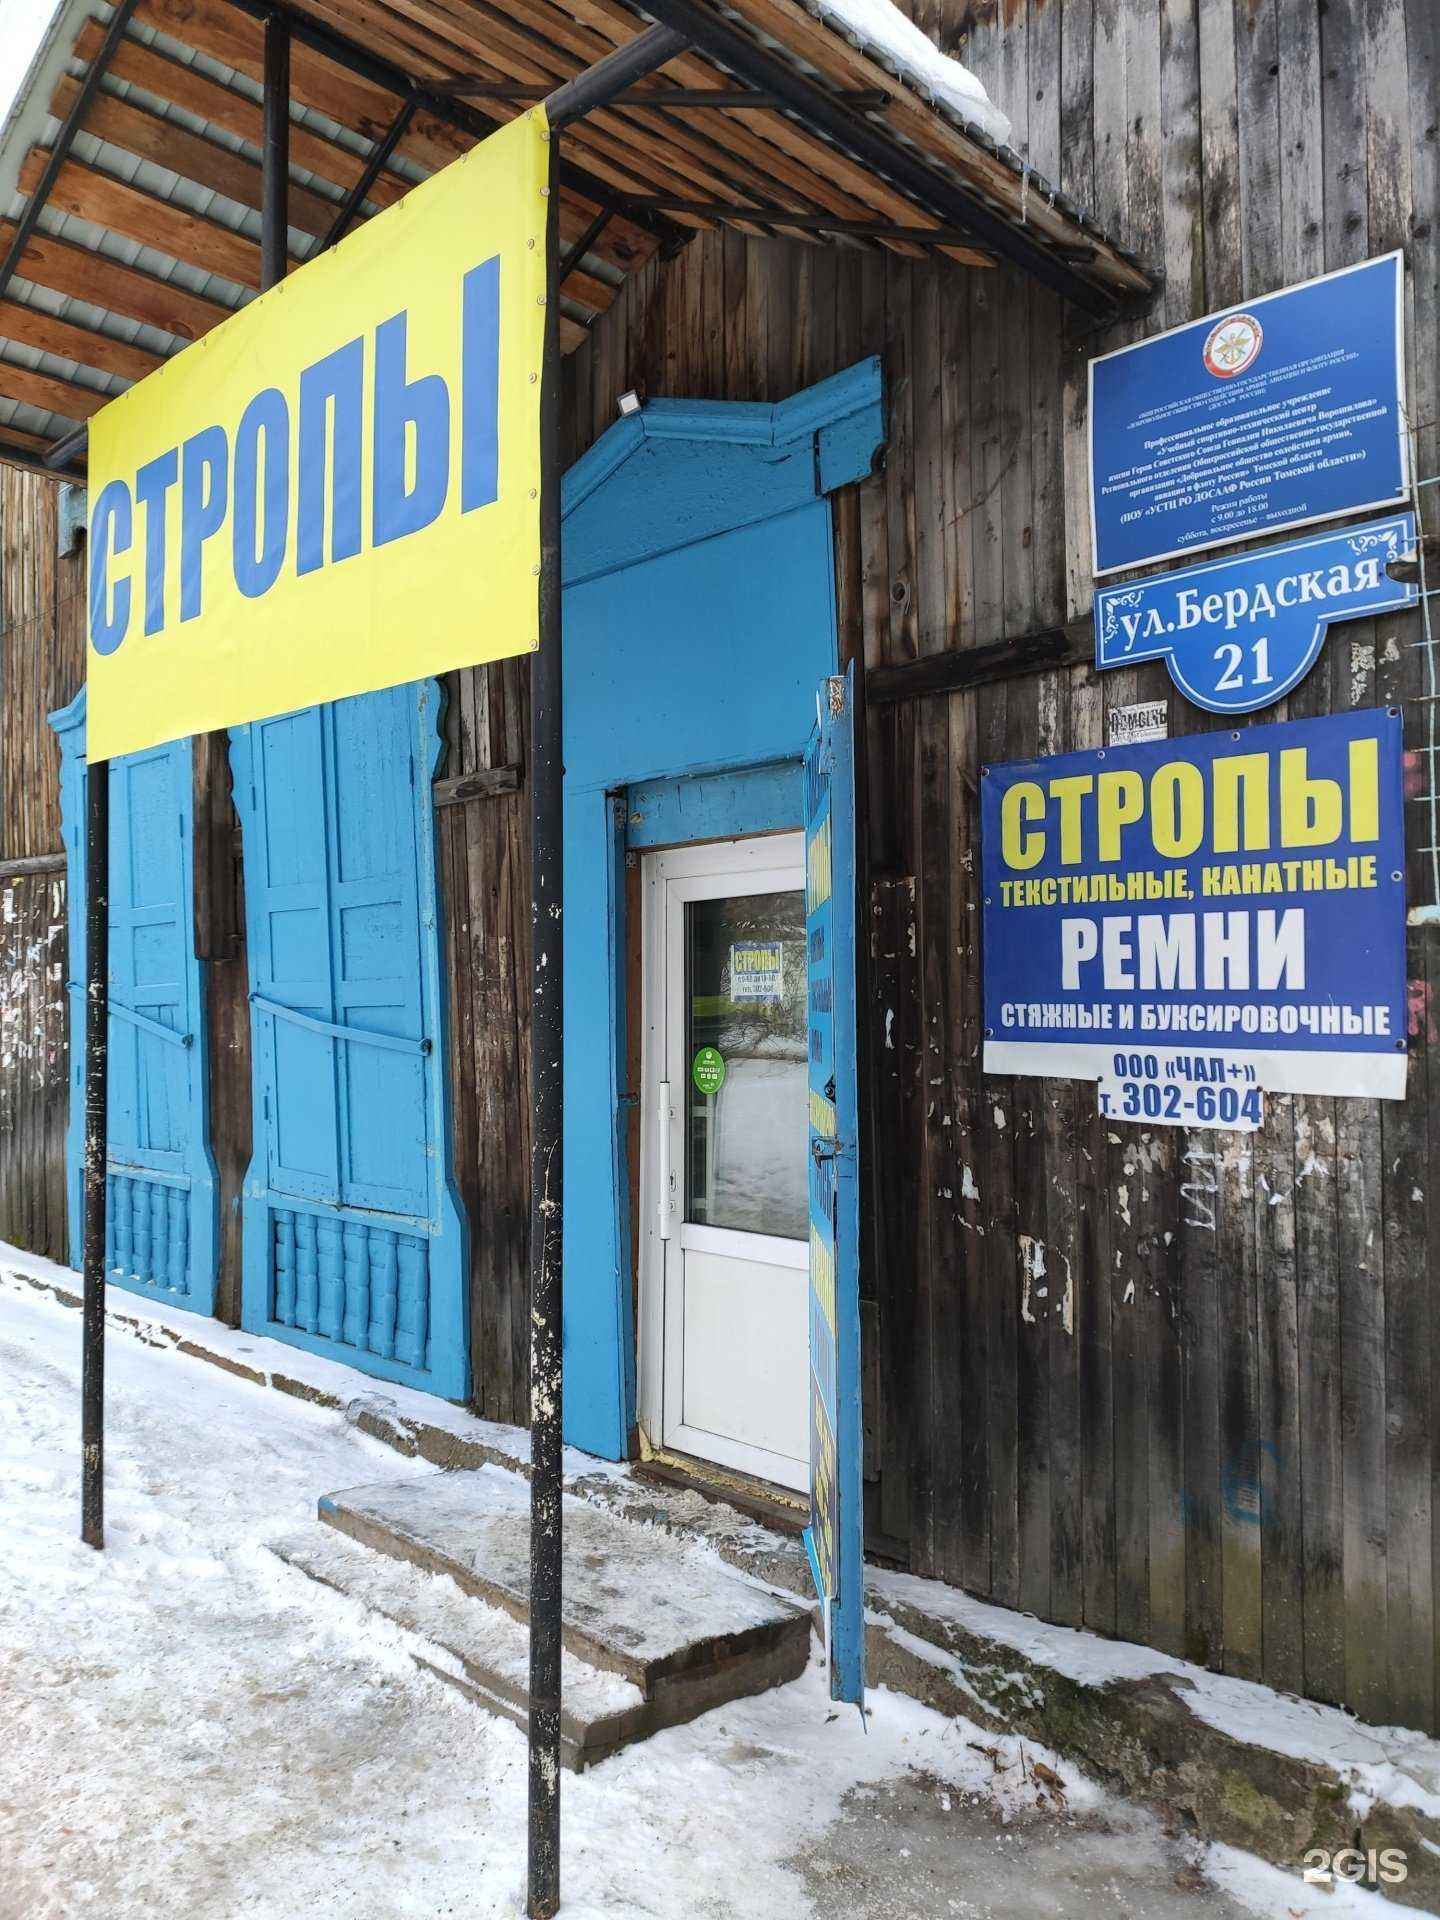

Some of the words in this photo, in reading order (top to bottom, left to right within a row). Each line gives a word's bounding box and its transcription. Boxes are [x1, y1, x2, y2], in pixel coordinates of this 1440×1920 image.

[90, 254, 500, 655] СТРОПЫ
[1214, 636, 1273, 692] 21
[1001, 738, 1380, 871] СТРОПЫ
[1000, 866, 1195, 908] ТЕКСТИЛЬНЫЕ,
[1202, 855, 1378, 896] КАНАТНЫЕ
[1062, 908, 1306, 991] РЕМНИ
[1001, 1003, 1113, 1030] СТЯЖНЫЕ
[1118, 1004, 1134, 1030] И
[1140, 1003, 1391, 1036] БУКСИРОВОЧНЫЕ
[1113, 1053, 1159, 1080] ООО
[1165, 1055, 1256, 1084] «ЧАЛ+»
[1100, 1093, 1117, 1114] т.
[1122, 1082, 1262, 1124] 302-604
